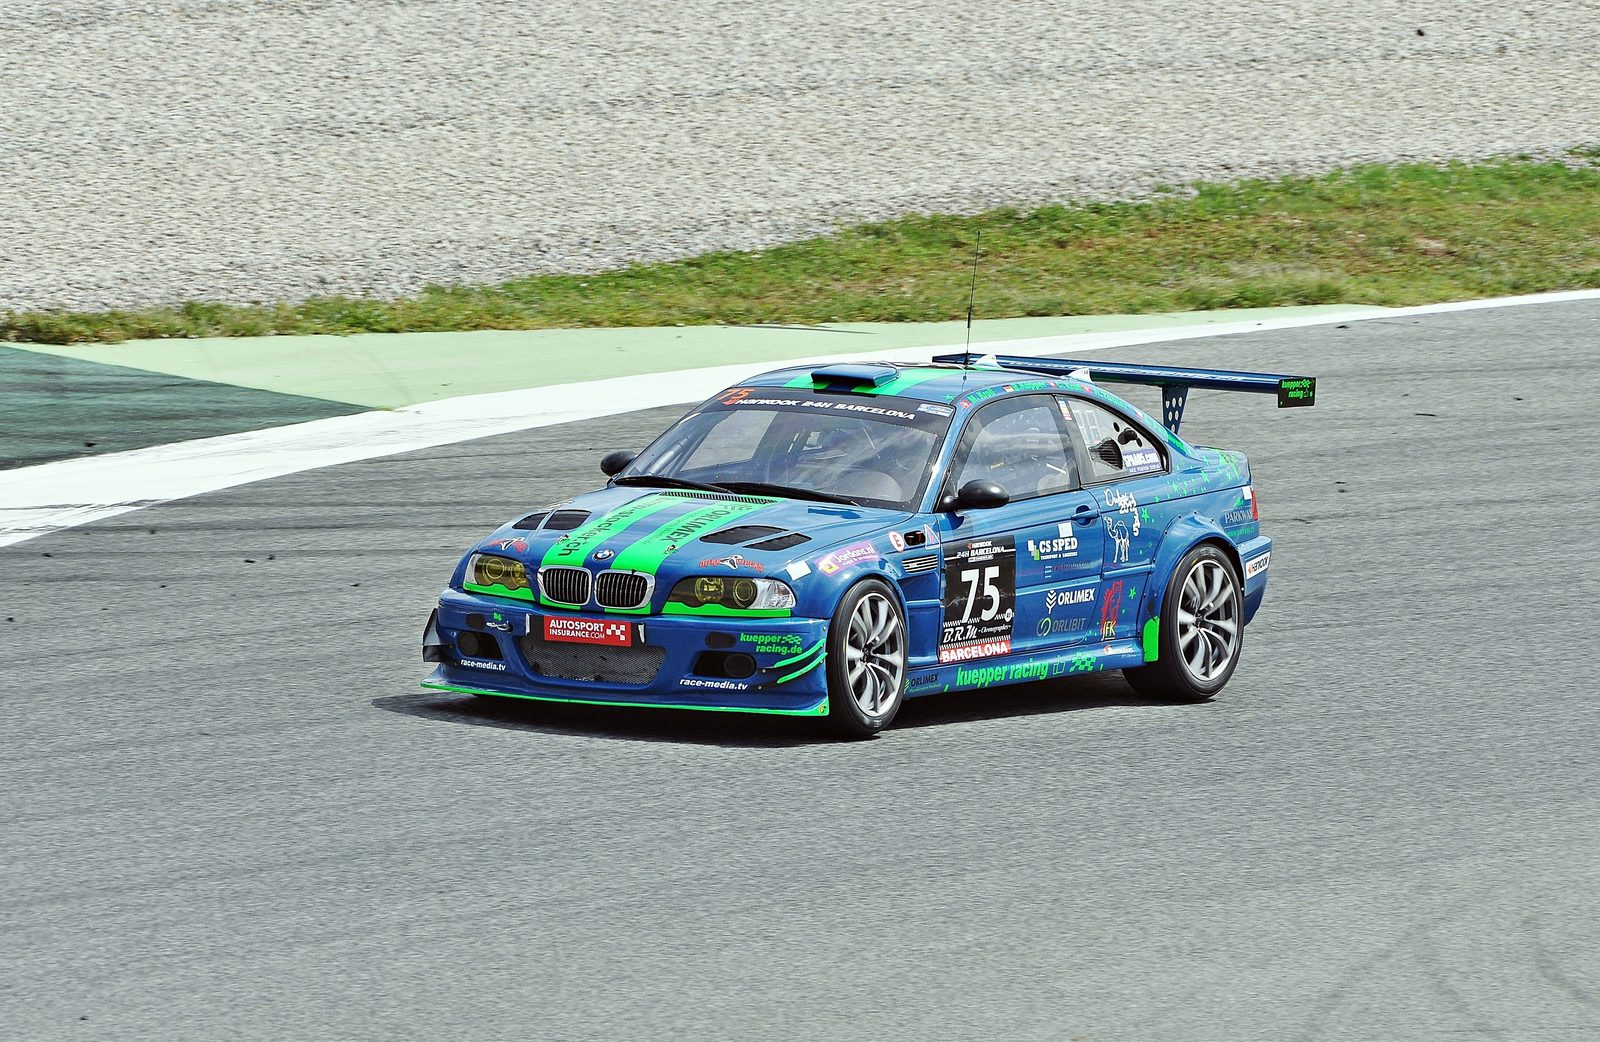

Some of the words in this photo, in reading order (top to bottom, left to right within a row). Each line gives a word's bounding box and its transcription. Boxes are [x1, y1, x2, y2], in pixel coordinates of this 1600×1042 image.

[717, 388, 755, 400] 75
[834, 403, 916, 420] BARCELONA
[661, 509, 731, 543] ORLIMEX
[970, 546, 1005, 557] BARCELONA
[1039, 540, 1052, 553] CS
[1052, 537, 1078, 552] SPED
[961, 565, 1000, 624] 75
[1057, 588, 1096, 605] ORLIMEX
[549, 619, 605, 632] AUTOSPORT
[1052, 617, 1086, 632] ORLIBIT
[1100, 620, 1117, 641] JFK
[549, 628, 605, 639] INSURANCE.COM
[740, 633, 782, 644] kuepper
[756, 644, 803, 655] racing.de
[942, 642, 1009, 663] BARCELONA
[460, 658, 507, 671] race-media.tv
[910, 673, 939, 687] ORLIMEX
[956, 667, 1008, 688] kuepper
[1009, 658, 1049, 680] racing
[679, 678, 749, 690] race-media.tv
